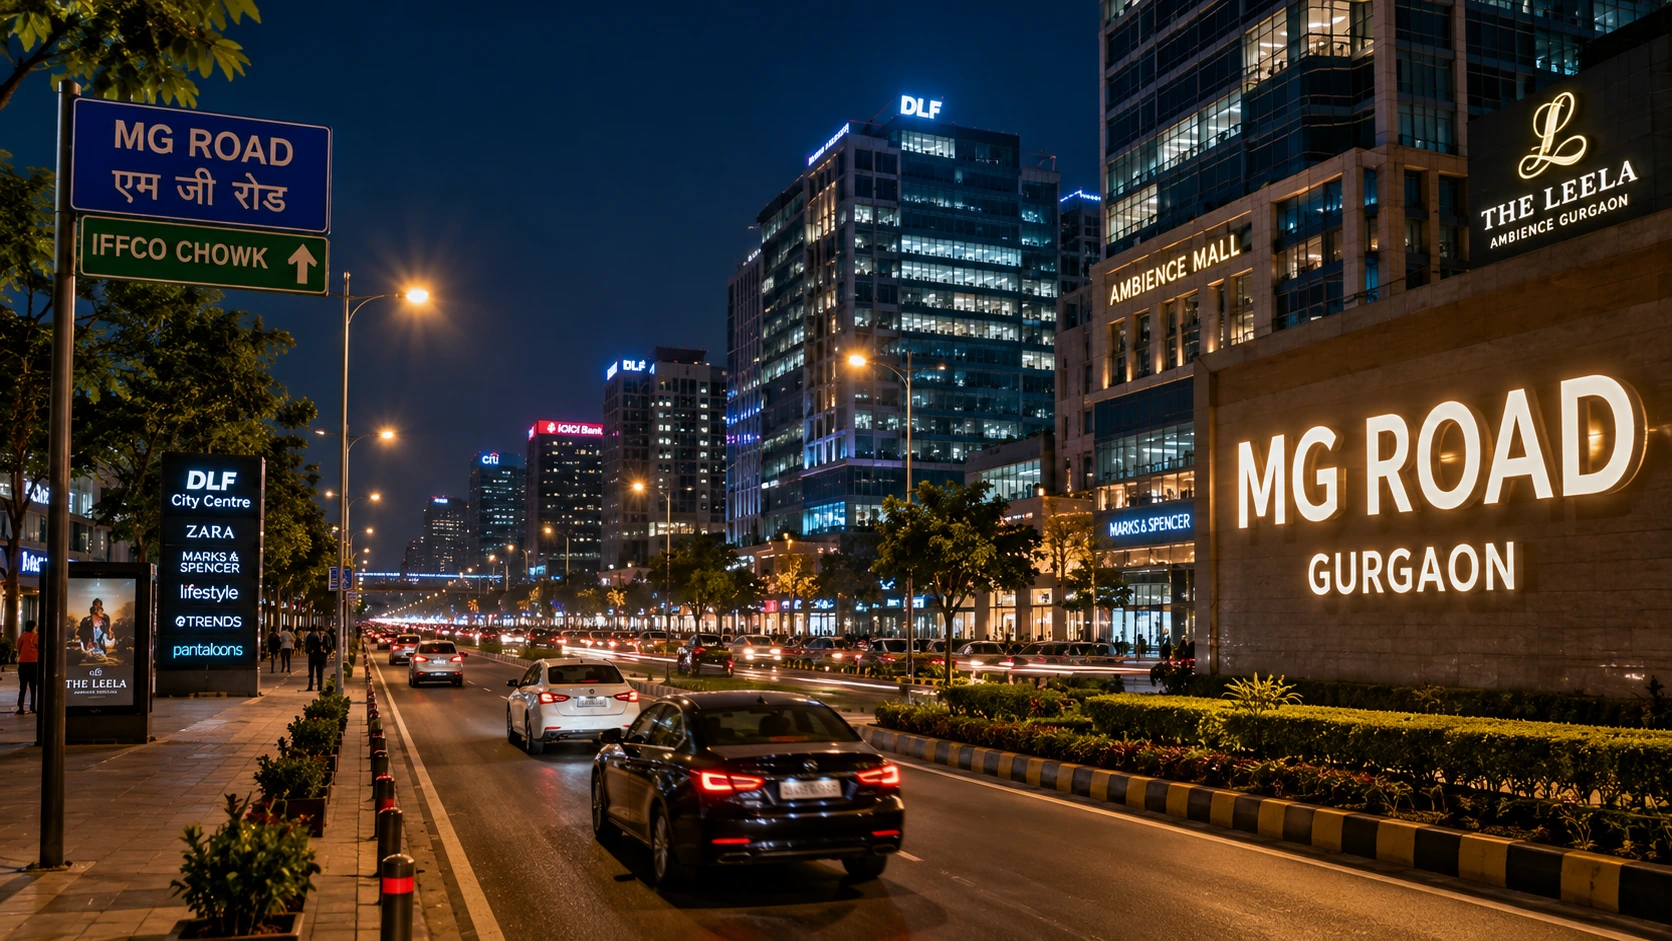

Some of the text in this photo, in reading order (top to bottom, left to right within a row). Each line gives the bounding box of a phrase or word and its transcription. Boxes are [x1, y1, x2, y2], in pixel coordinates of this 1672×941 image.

[900, 94, 943, 119] DLF
[114, 119, 294, 167] MG ROAD
[111, 167, 288, 212] एम जी रोड
[1480, 159, 1638, 231] THE LEELA
[1490, 193, 1629, 249] AMBIENCE GURGAON
[92, 233, 268, 269] IFFCO CHOWK
[1109, 234, 1240, 306] AMBIENCE MALL
[623, 360, 646, 371] DLF
[557, 423, 603, 435] ICICI Bank
[1238, 374, 1636, 529] MG ROAD
[186, 470, 237, 491] DLF
[171, 493, 251, 509] City Centre
[186, 525, 235, 539] ZARA
[1109, 520, 1140, 537] MARKS
[1148, 513, 1190, 532] SPENCER
[182, 551, 239, 562] MARKS &
[180, 562, 240, 573] SPENCER
[1308, 541, 1515, 595] GURGAON
[180, 584, 239, 603] lifestyle
[186, 616, 242, 627] TRENDS
[173, 643, 243, 659] pantaloons
[65, 679, 127, 689] THE LEELA
